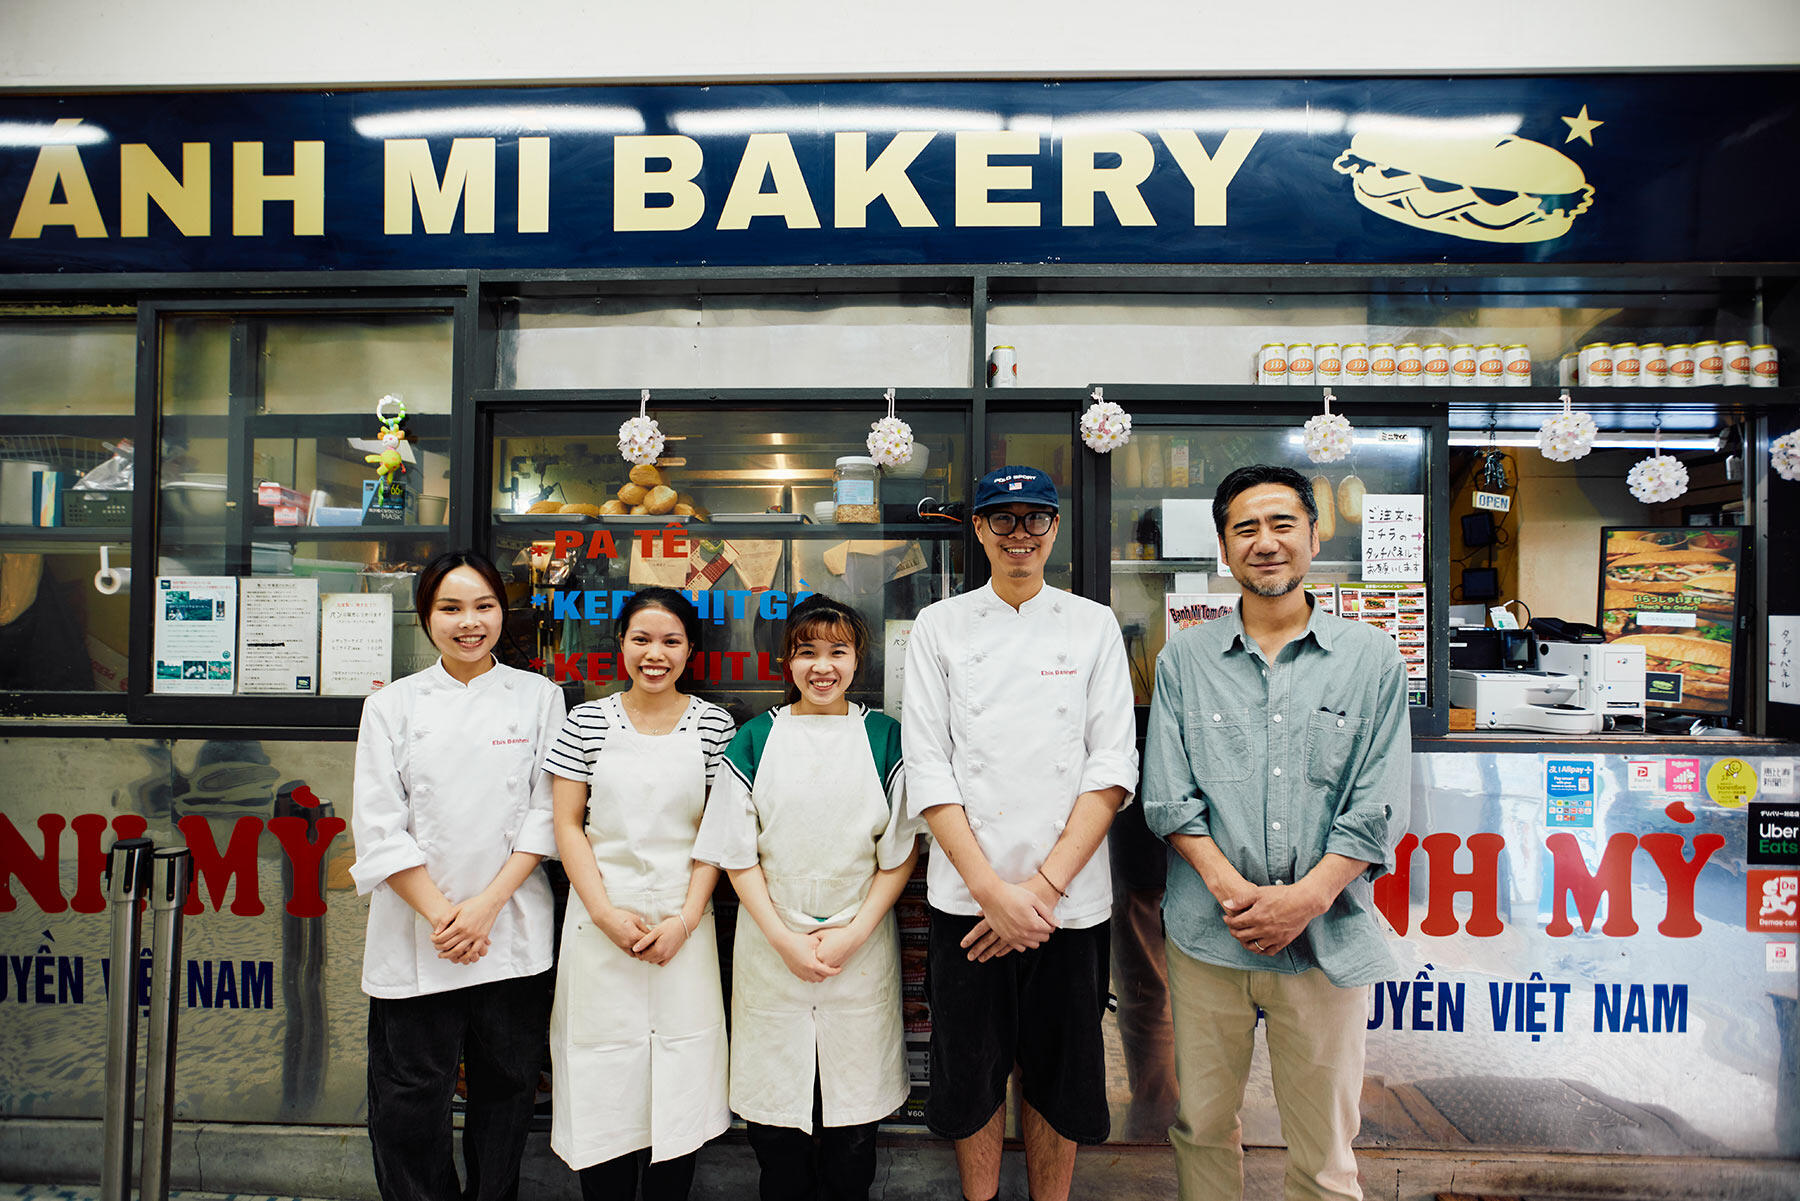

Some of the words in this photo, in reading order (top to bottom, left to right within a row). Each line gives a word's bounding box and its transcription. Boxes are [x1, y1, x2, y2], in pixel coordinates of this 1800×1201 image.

[613, 129, 1265, 232] BAKERY
[1479, 494, 1509, 510] OPEN
[381, 513, 402, 521] MASK
[633, 521, 689, 559] TÊ
[1633, 594, 1703, 605] いらっしゃいませ
[1759, 823, 1800, 839] Uber
[1759, 839, 1799, 854] Eats
[1781, 880, 1796, 891] De
[1759, 918, 1798, 927] Demae-can
[187, 959, 275, 1010] NAM
[1488, 971, 1570, 1043] VIỆT
[1593, 982, 1689, 1034] NAM
